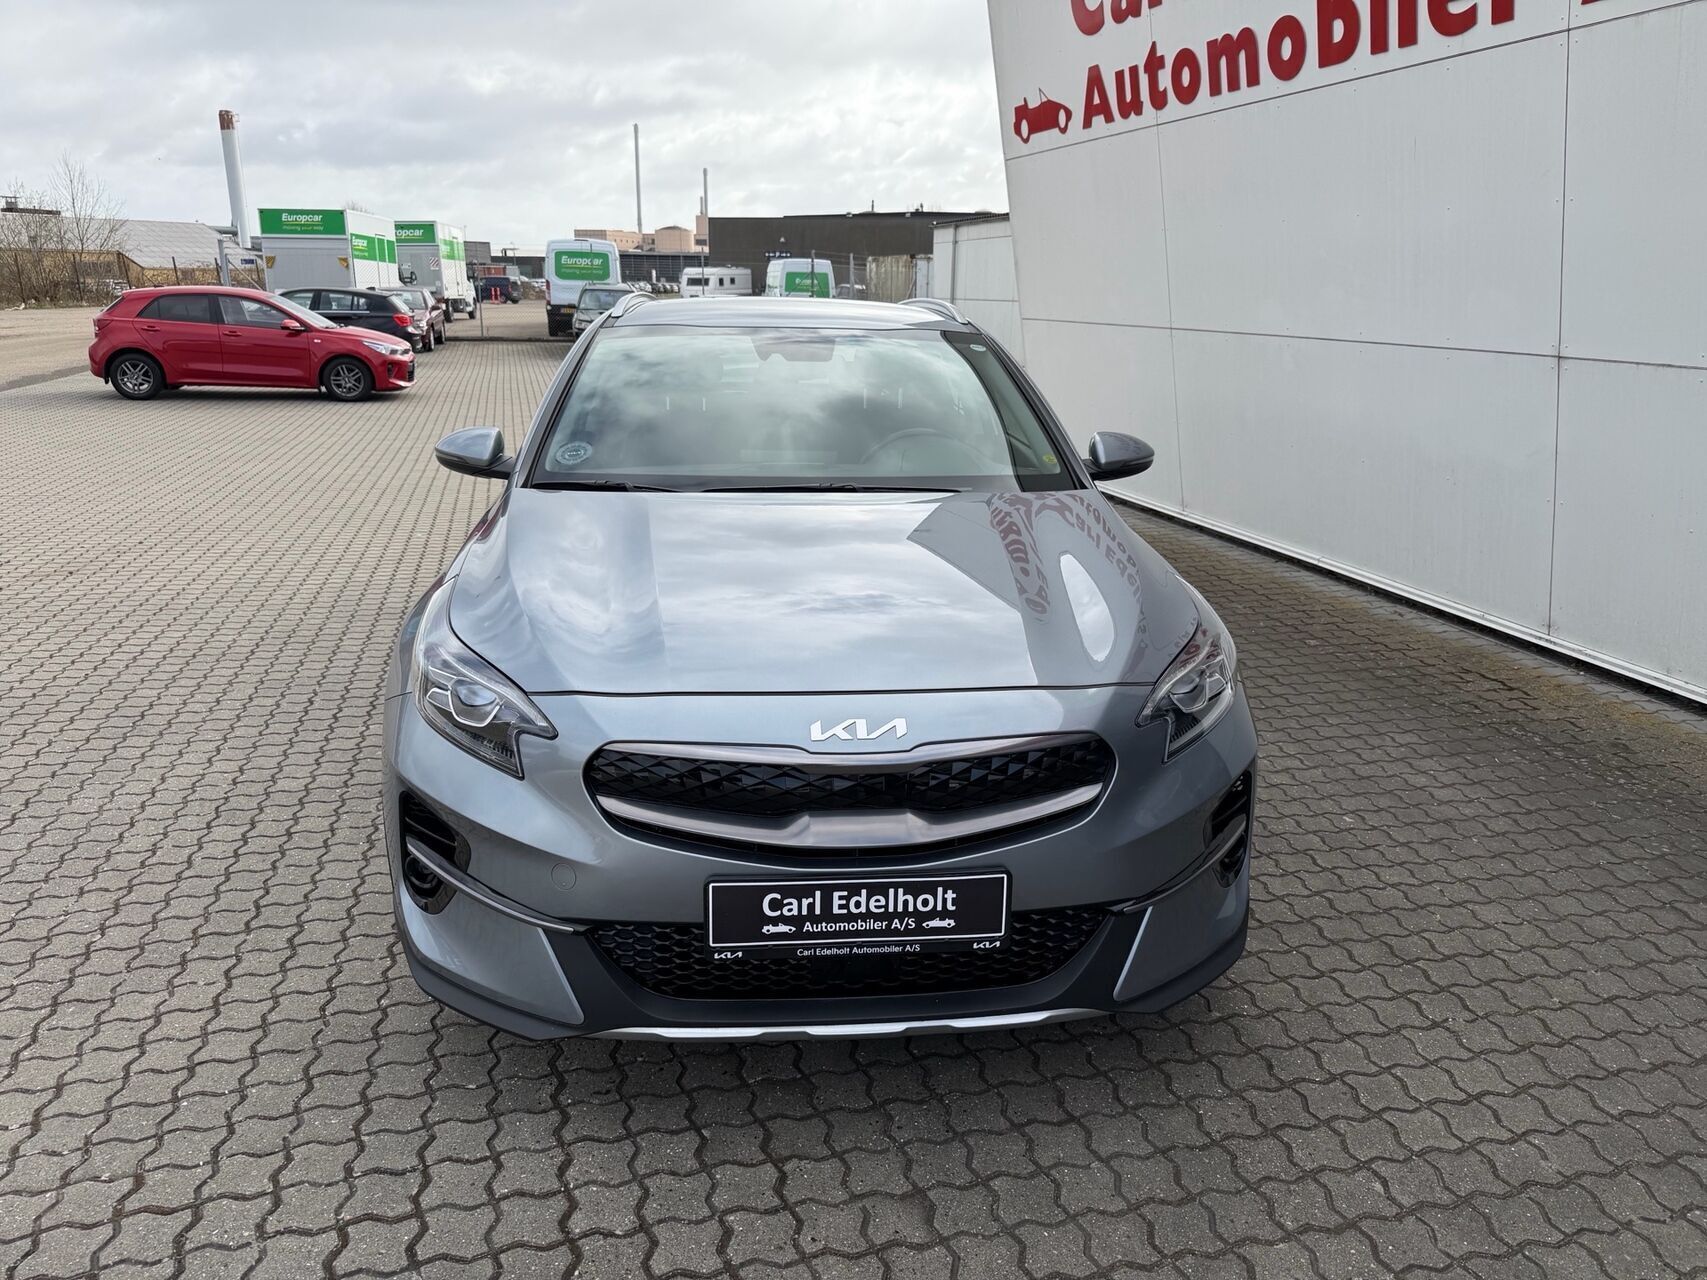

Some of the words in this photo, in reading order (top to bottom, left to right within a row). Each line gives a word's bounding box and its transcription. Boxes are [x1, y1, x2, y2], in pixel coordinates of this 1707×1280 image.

[282, 213, 323, 223] Europcar
[561, 256, 603, 267] Europcar
[810, 718, 908, 742] KIA
[762, 890, 821, 917] Carl
[832, 886, 957, 914] Edelholt
[803, 918, 888, 933] Automobiler
[890, 917, 916, 931] A/S
[797, 948, 814, 956] Carl
[816, 947, 850, 956] Edelholt
[852, 945, 903, 954] Automobiler
[904, 944, 921, 952] A/S
[973, 941, 1001, 949] KIA
[713, 951, 743, 959] KIA
